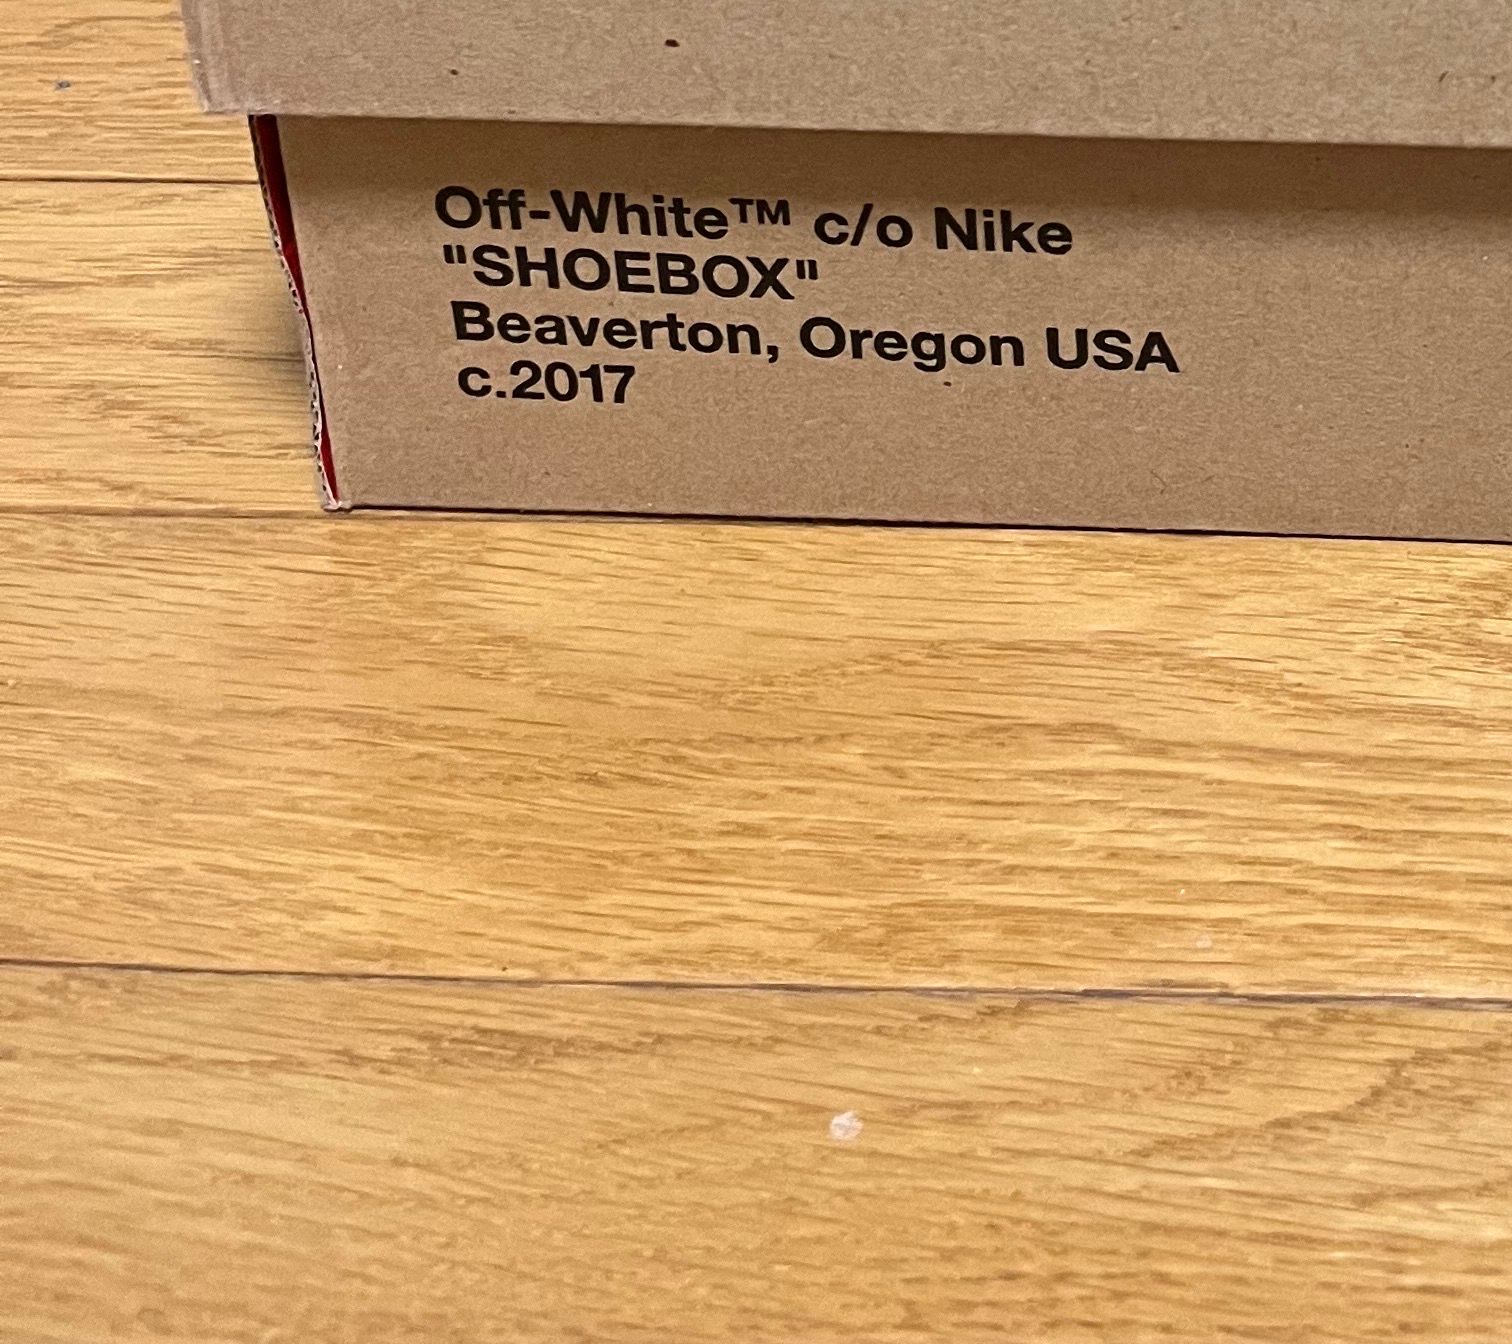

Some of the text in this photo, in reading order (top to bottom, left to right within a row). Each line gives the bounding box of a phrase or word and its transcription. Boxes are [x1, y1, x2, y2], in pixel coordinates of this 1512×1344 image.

[813, 202, 914, 248] c/o
[933, 206, 1073, 256] Nike
[442, 244, 819, 300] "SHOEBOX"
[450, 300, 1181, 374] Beaverton, Oregon USA
[457, 359, 636, 404] c.2017
